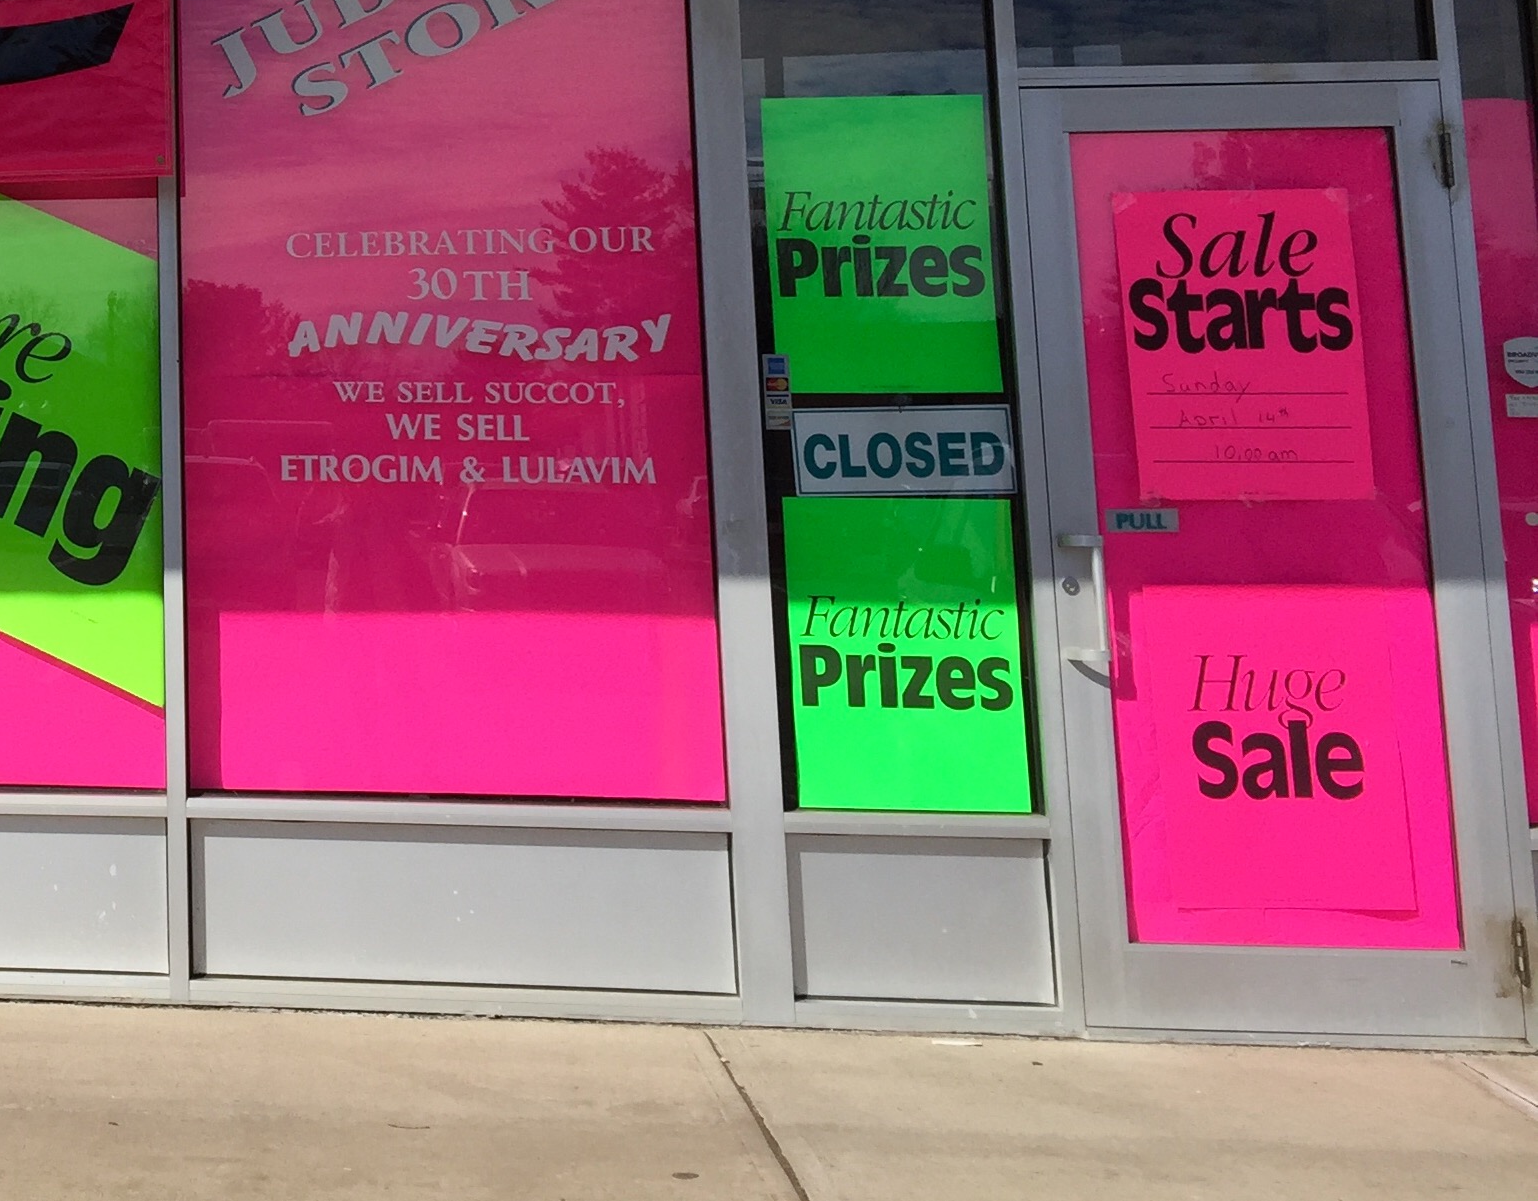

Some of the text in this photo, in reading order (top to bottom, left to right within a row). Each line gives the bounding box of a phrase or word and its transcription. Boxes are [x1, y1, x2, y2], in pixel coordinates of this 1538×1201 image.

[776, 190, 977, 232] Fantastic
[285, 226, 655, 258] CELEBRATING OUR
[1155, 211, 1318, 279] Sale
[407, 267, 533, 301] 30TH
[775, 235, 986, 298] Prizes
[288, 311, 671, 362] ANNIVERSARY
[1128, 278, 1354, 354] Starts
[333, 380, 625, 408] WE SELL SUCCOT,
[1162, 371, 1251, 403] Sunday
[385, 413, 530, 441] WE SELL
[1179, 408, 1238, 427] April
[280, 454, 657, 484] ETROGIM & LULAVIM
[803, 431, 1005, 480] CLOSED
[1268, 450, 1298, 461] am
[1116, 513, 1168, 530] PULL
[800, 594, 1005, 641] Fantastic
[798, 643, 1014, 712] Prizes
[1188, 654, 1346, 728] Huge
[1192, 719, 1364, 799] Sale
